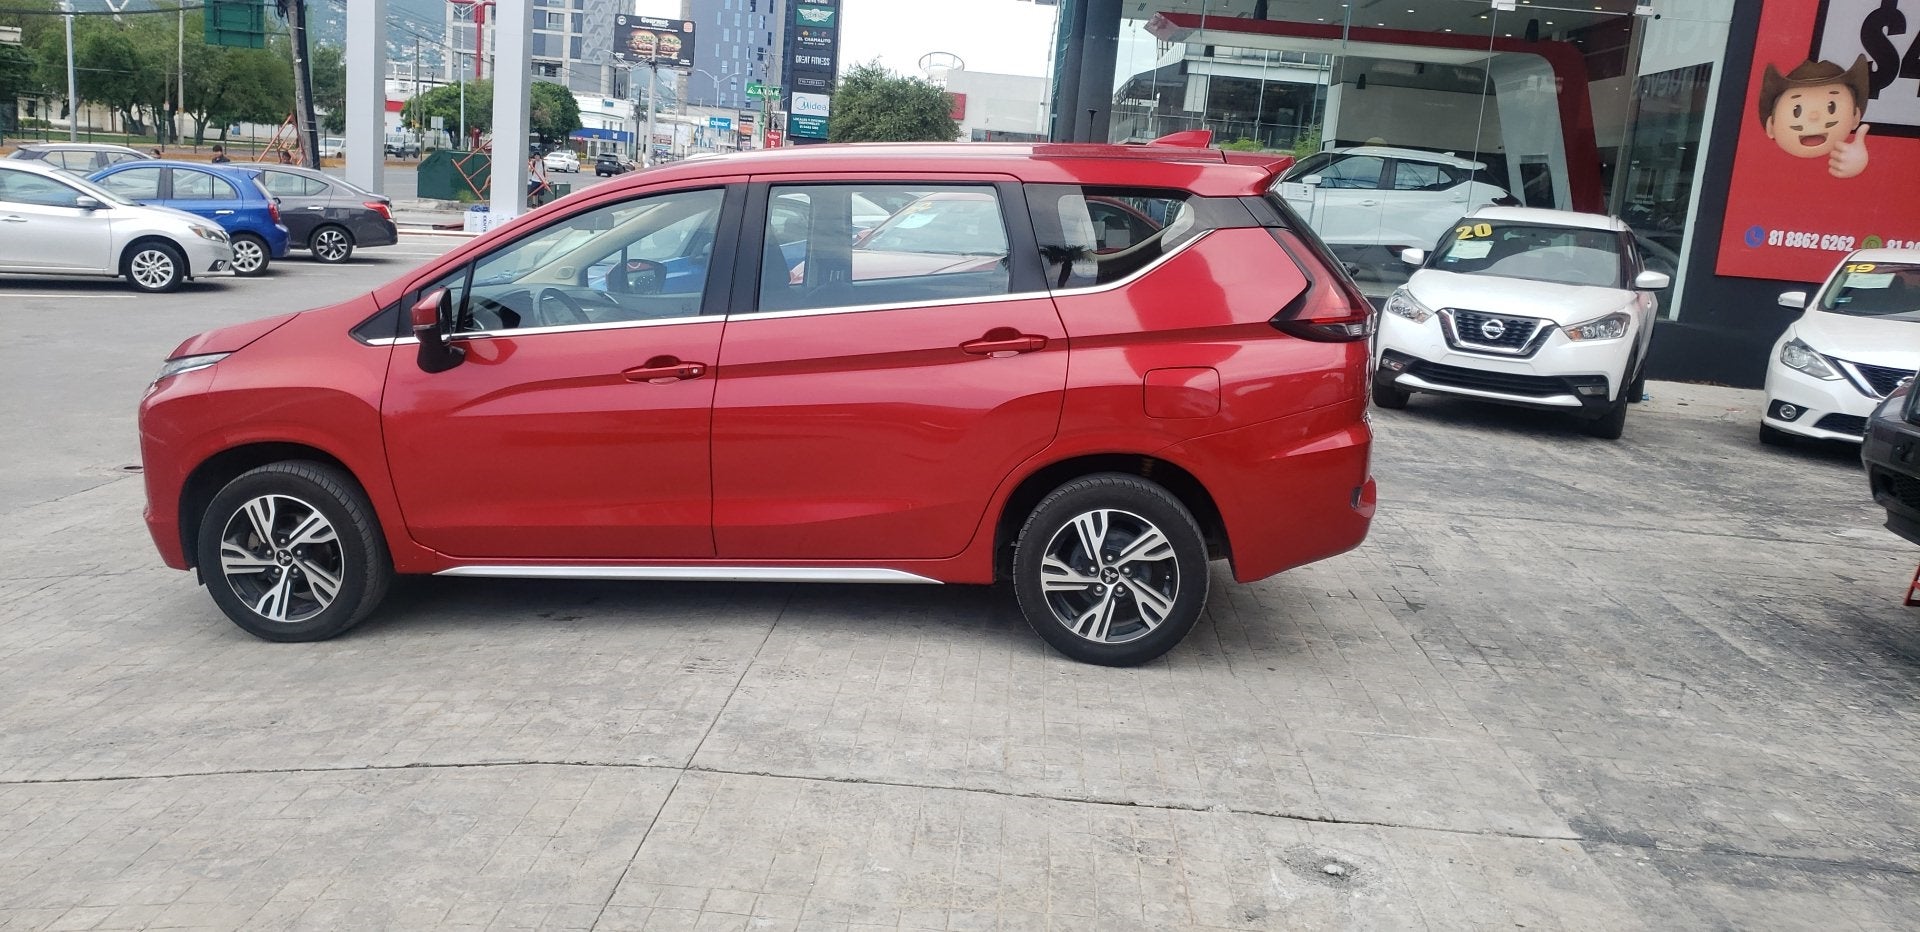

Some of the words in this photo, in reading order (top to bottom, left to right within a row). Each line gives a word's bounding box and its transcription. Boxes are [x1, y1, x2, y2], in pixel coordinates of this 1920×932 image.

[795, 54, 810, 65] GREAT
[811, 56, 830, 66] FITNESS
[795, 97, 827, 110] Midea
[1455, 223, 1493, 240] 20
[1768, 229, 1784, 246] 81
[1785, 231, 1820, 249] 8862
[1821, 234, 1855, 251] 6262
[1847, 264, 1876, 273] 19
